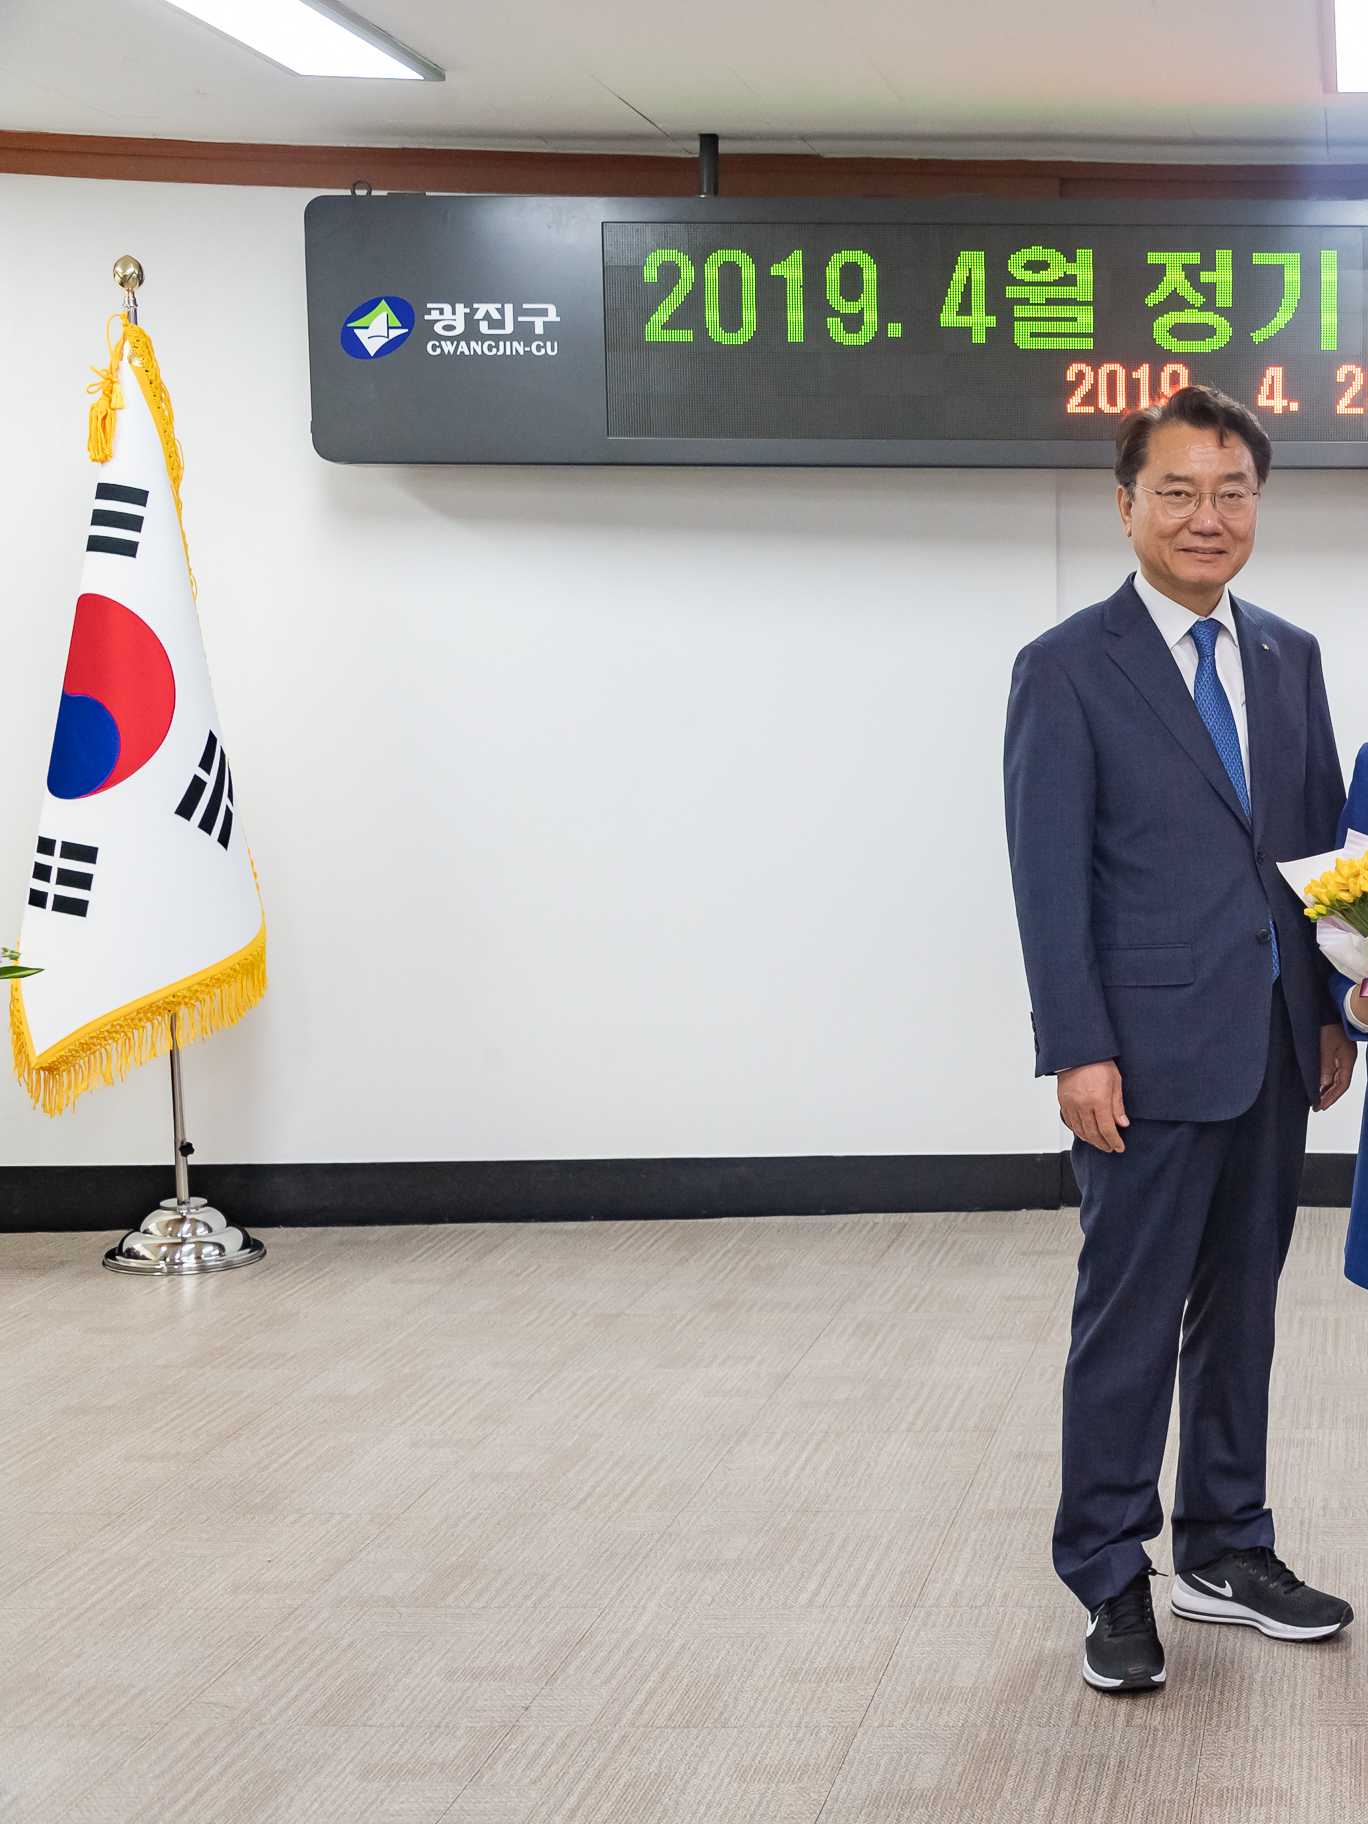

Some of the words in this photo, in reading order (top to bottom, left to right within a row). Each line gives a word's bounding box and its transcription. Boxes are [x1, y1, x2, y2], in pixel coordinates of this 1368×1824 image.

[642, 247, 903, 346] 2019.
[938, 244, 1095, 350] 4월
[1143, 248, 1339, 353] 정기
[424, 303, 561, 337] 광진구
[426, 340, 558, 356] GWANGJIN-GU
[1256, 365, 1300, 415] 4.
